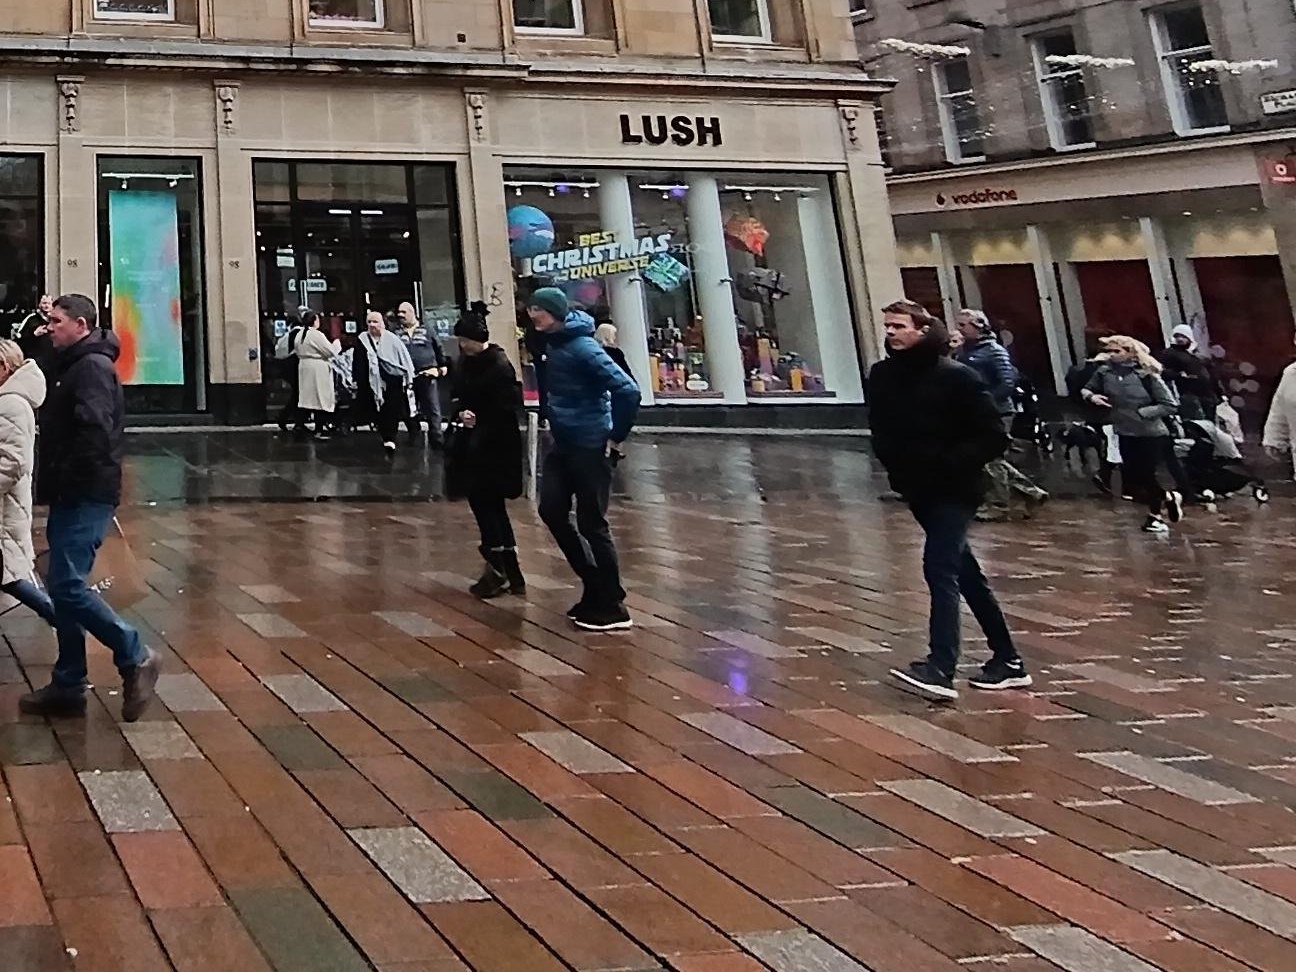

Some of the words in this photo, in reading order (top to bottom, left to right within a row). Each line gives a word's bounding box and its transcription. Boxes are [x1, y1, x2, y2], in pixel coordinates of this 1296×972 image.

[619, 114, 723, 147] LUSH
[952, 188, 1018, 205] vodafone
[579, 231, 616, 247] BEST
[532, 234, 671, 273] CHRISTMAS
[568, 255, 651, 281] UNIVERSE
